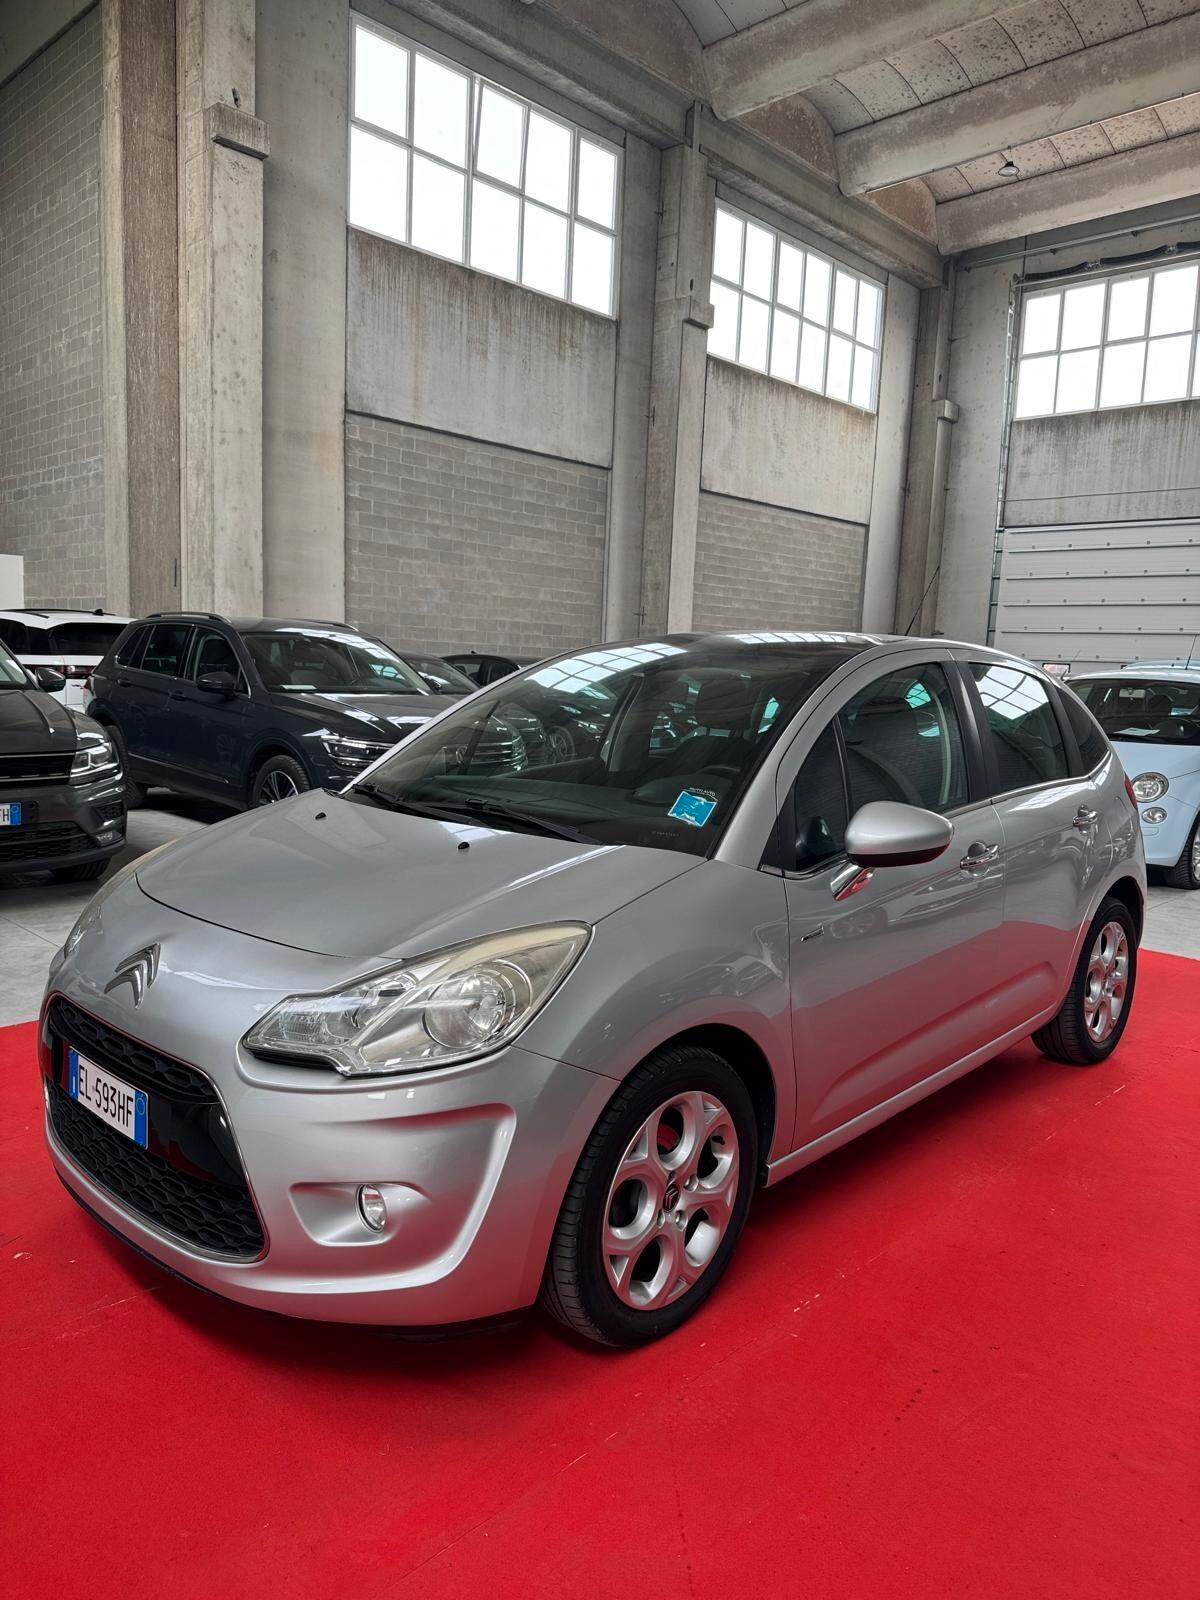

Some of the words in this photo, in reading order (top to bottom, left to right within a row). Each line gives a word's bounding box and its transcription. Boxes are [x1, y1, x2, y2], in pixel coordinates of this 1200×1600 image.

[0, 808, 9, 822] H
[79, 1064, 92, 1101] EL
[95, 1077, 134, 1128] 593HF
